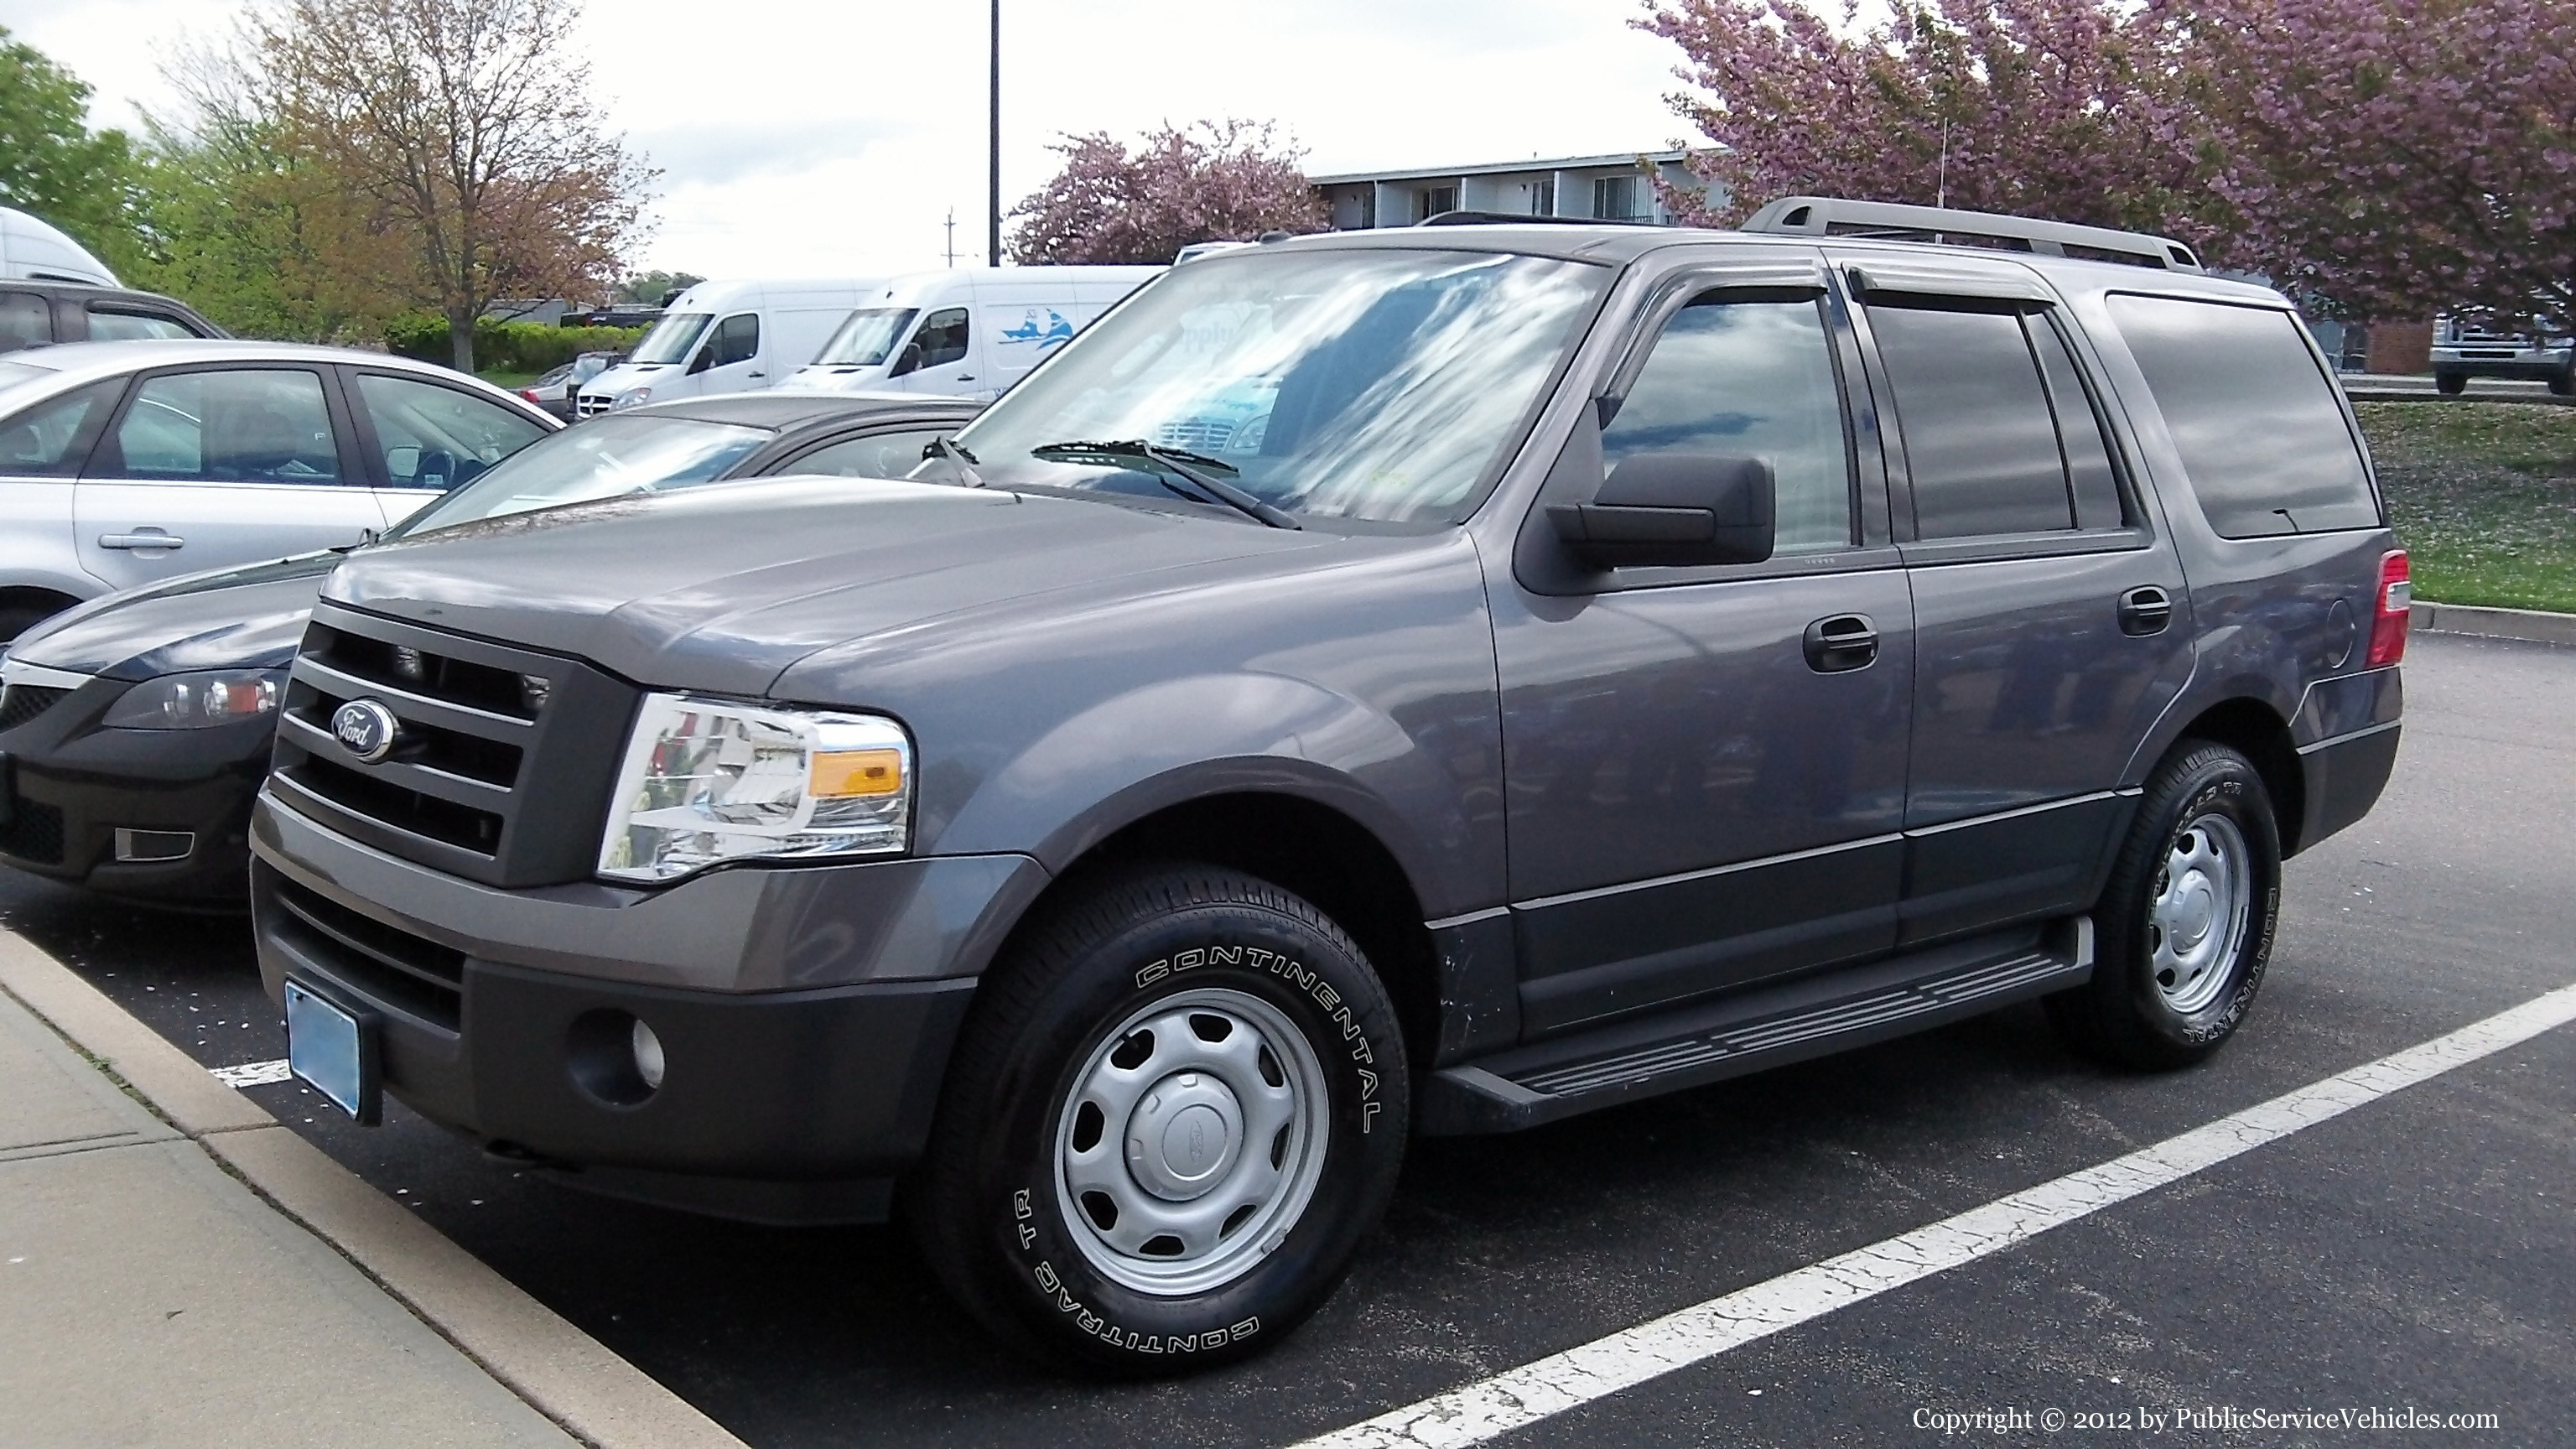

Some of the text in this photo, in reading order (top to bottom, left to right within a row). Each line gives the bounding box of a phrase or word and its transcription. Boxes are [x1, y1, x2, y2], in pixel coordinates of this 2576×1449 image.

[338, 709, 372, 746] Ford
[1135, 945, 1382, 1134] CONTINENTAL
[1014, 1187, 1259, 1353] CONTITRAC TR
